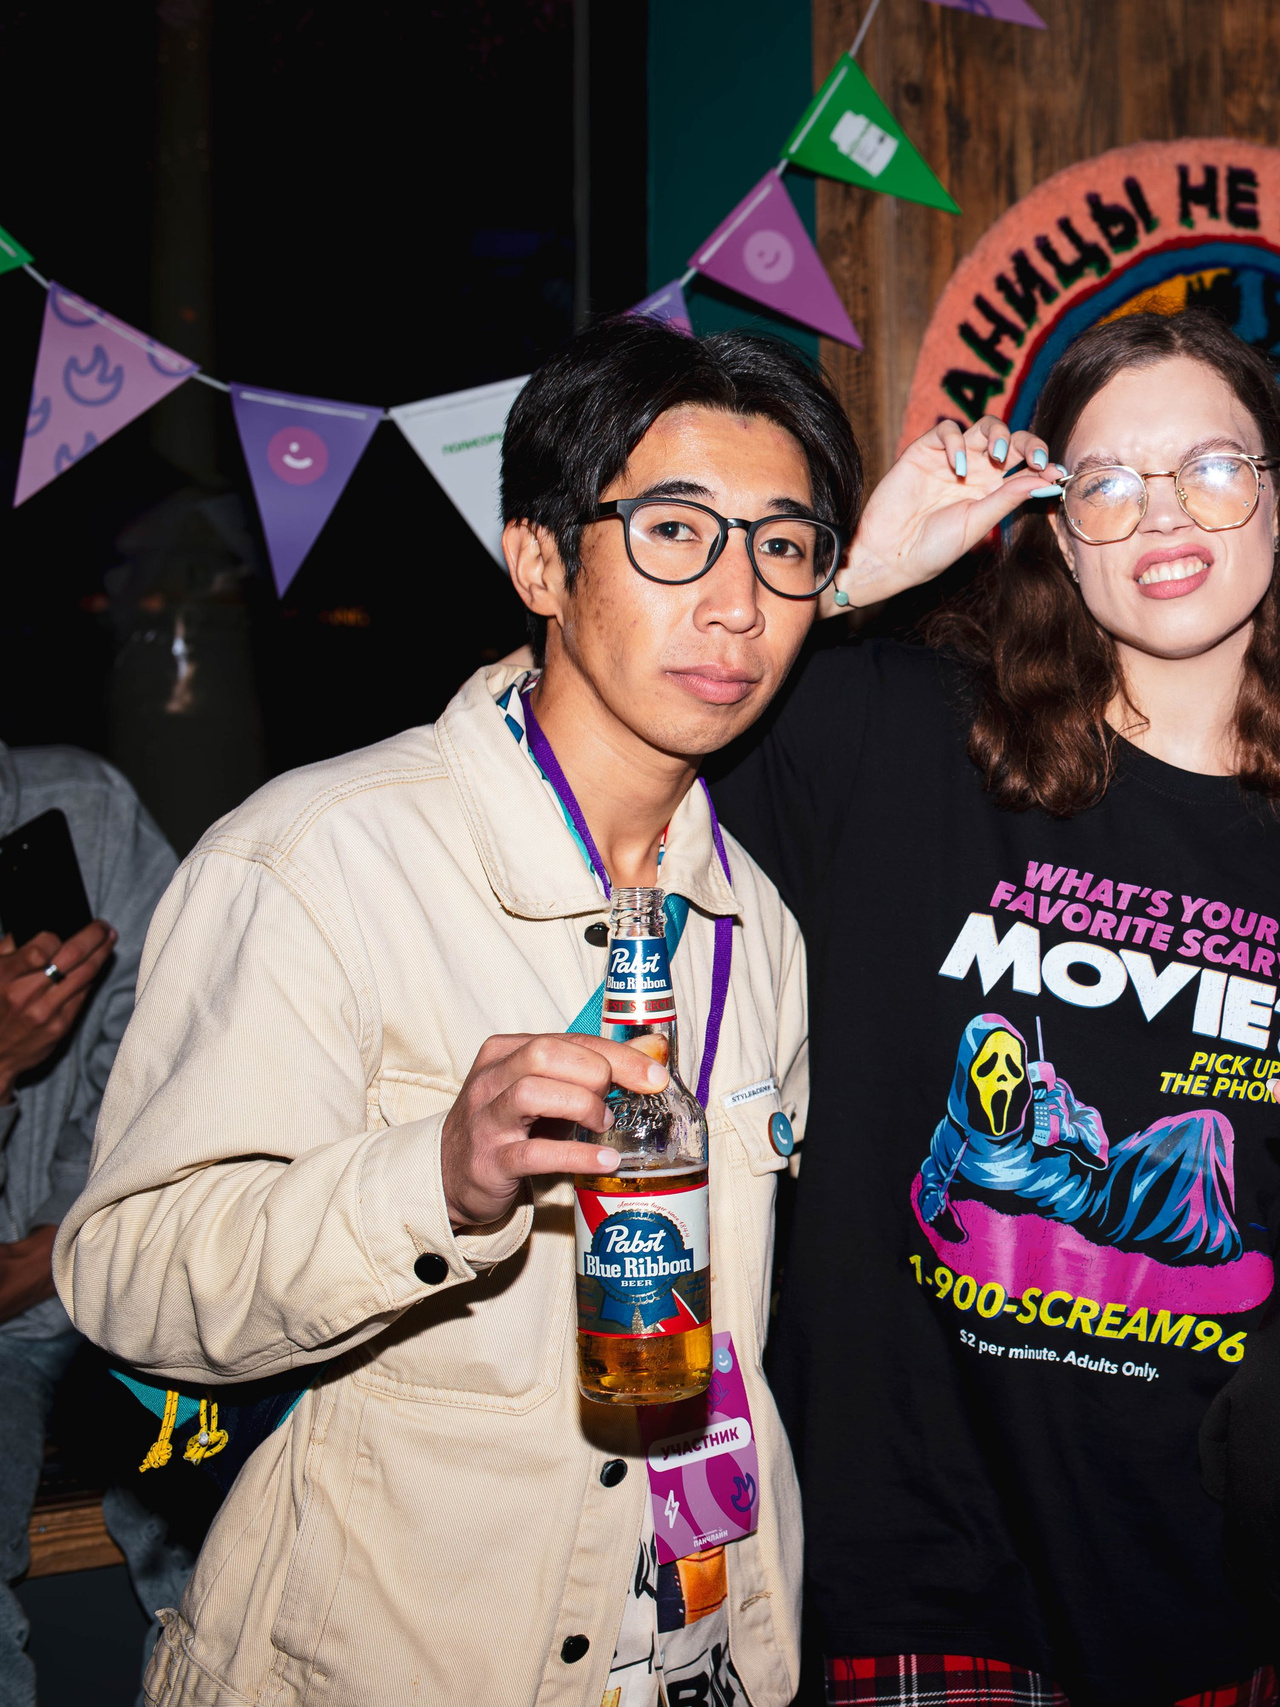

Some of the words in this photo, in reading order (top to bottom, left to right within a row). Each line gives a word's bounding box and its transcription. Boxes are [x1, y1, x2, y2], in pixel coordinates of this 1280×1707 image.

[937, 176, 1159, 432] АНИЦЫ
[1178, 165, 1260, 230] НЕ
[989, 880, 1175, 952] FAVORITE
[1025, 860, 1173, 918] WHAT'S
[1180, 894, 1280, 946] YOUR
[611, 948, 660, 973] Pabst
[607, 976, 625, 990] Blue
[629, 998, 669, 1012] SLECT
[1189, 1051, 1251, 1076] PICK
[1160, 1071, 1210, 1096] THE
[1212, 1077, 1278, 1104] PHO
[617, 1200, 649, 1209] American
[651, 1202, 668, 1212] lager
[604, 1225, 666, 1253] Pabst
[586, 1254, 621, 1278] Blue
[624, 1255, 691, 1278] Ribbon
[908, 1254, 1248, 1363] 1-900-SCREAM96
[959, 1329, 976, 1348] $2
[978, 1339, 1006, 1357] per
[1008, 1344, 1061, 1362] minute.
[1063, 1350, 1119, 1375] Adults
[1121, 1361, 1160, 1382] Only.
[660, 1426, 740, 1461] УЧАСТНИК
